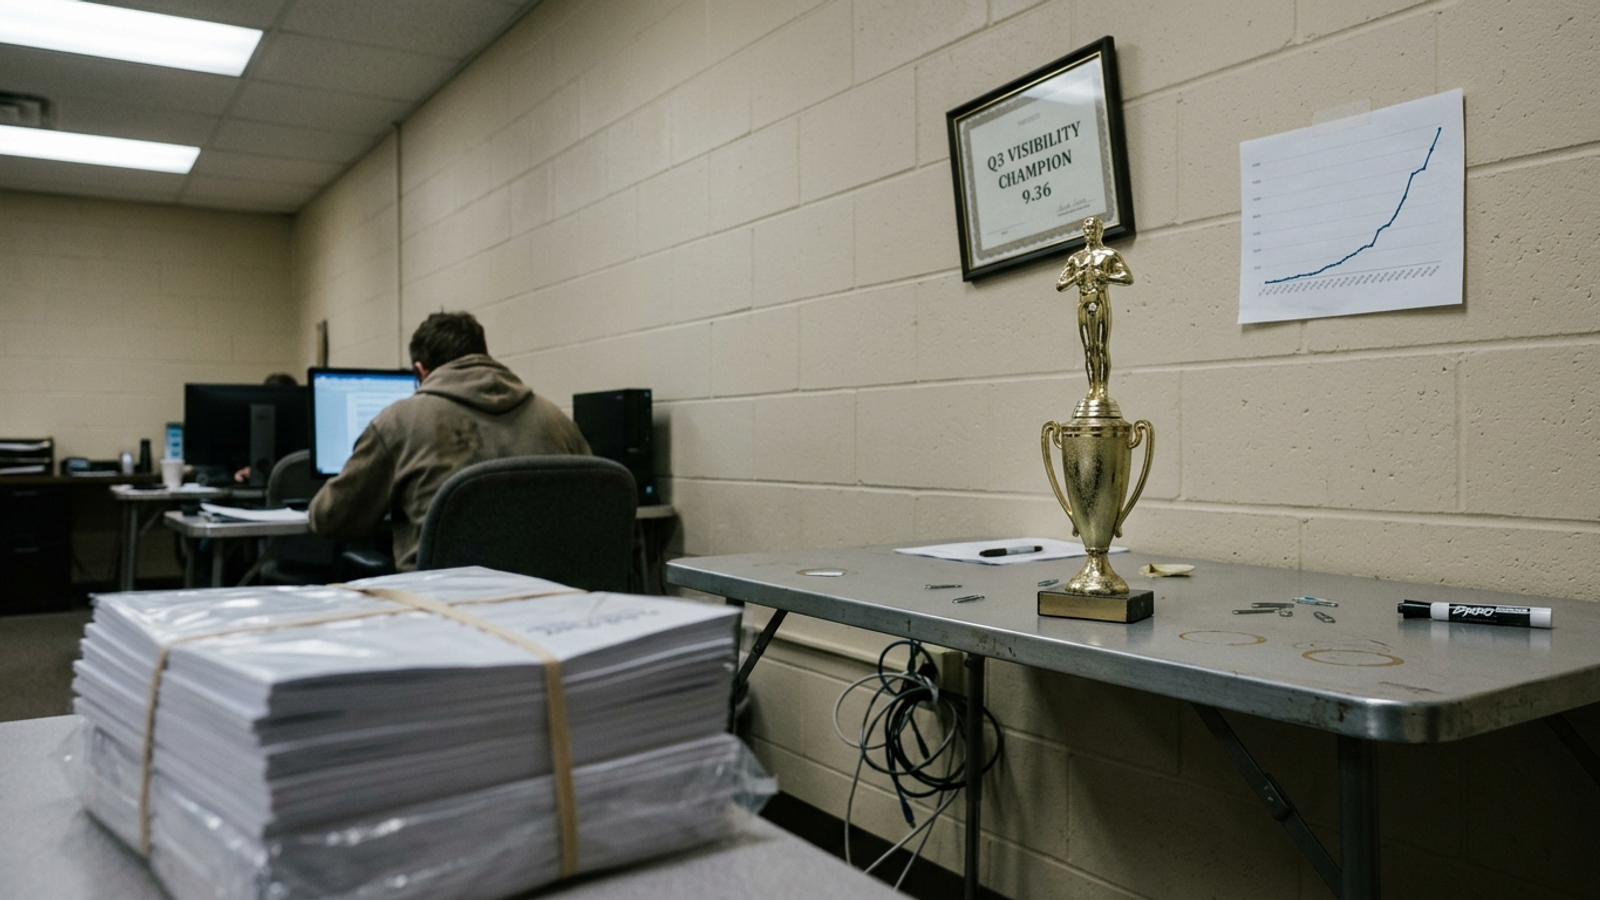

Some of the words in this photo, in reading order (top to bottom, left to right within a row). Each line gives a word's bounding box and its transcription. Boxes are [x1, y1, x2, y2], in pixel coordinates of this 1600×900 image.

[987, 152, 1005, 172] Q3
[1007, 120, 1081, 162] VISIBILITY
[998, 149, 1072, 189] CHAMPION
[1021, 181, 1052, 204] 9.36
